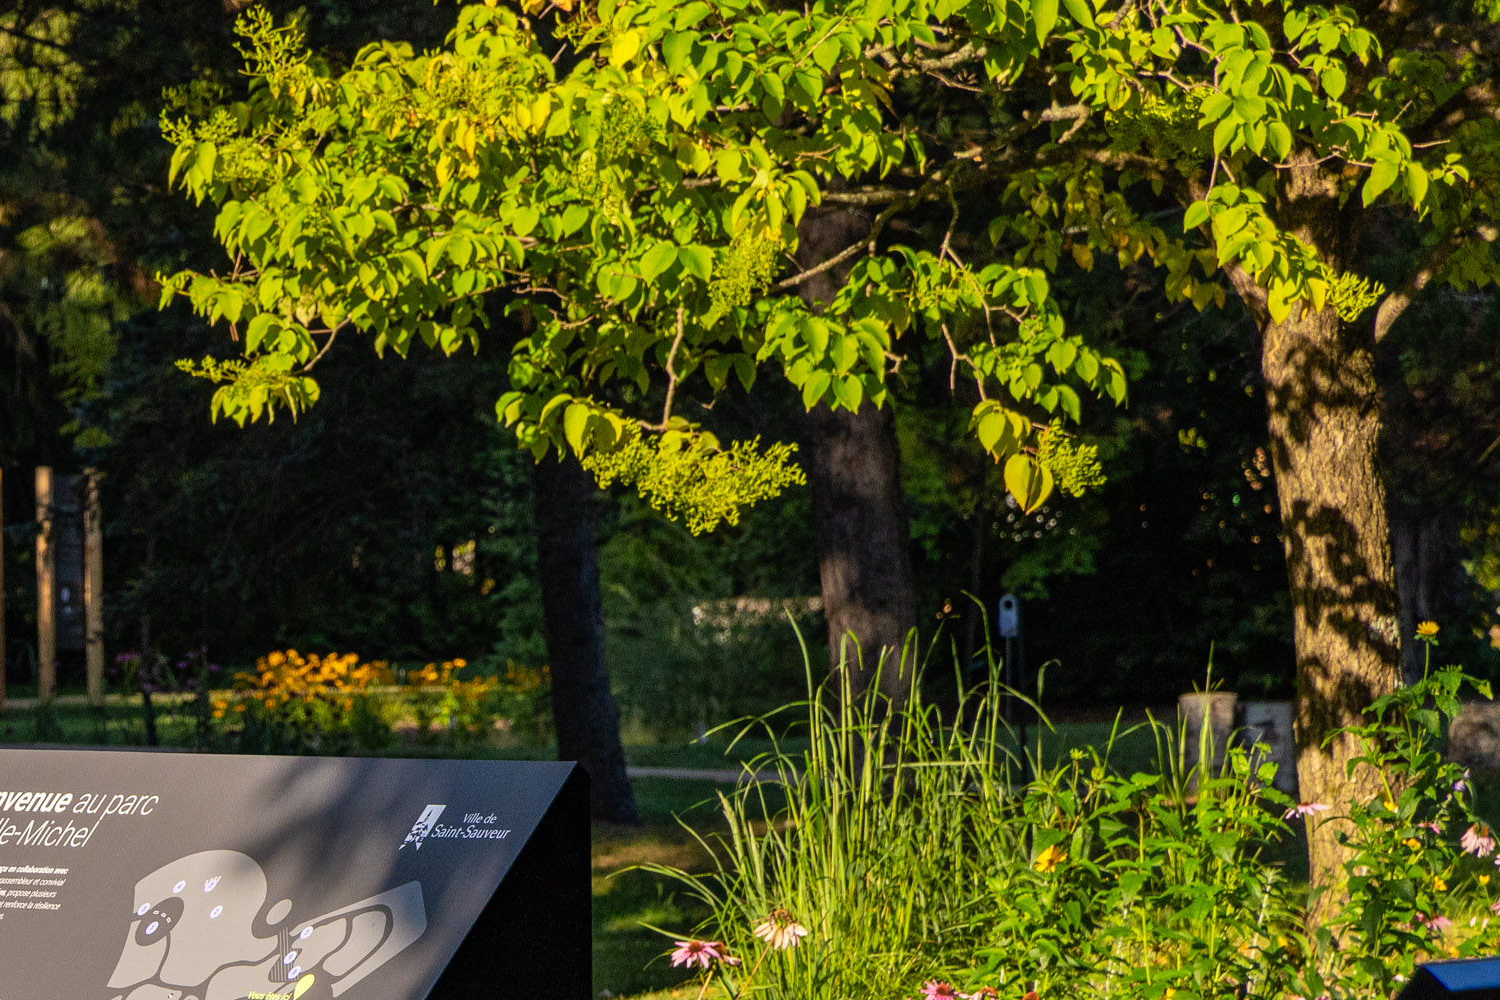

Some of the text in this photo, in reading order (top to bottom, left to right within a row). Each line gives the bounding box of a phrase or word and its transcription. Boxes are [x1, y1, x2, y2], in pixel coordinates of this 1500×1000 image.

[72, 793, 107, 814] au
[98, 794, 160, 821] parc
[462, 813, 498, 824] Ville de
[431, 824, 511, 839] Saint-Sauveur
[247, 990, 266, 1000] Vous
